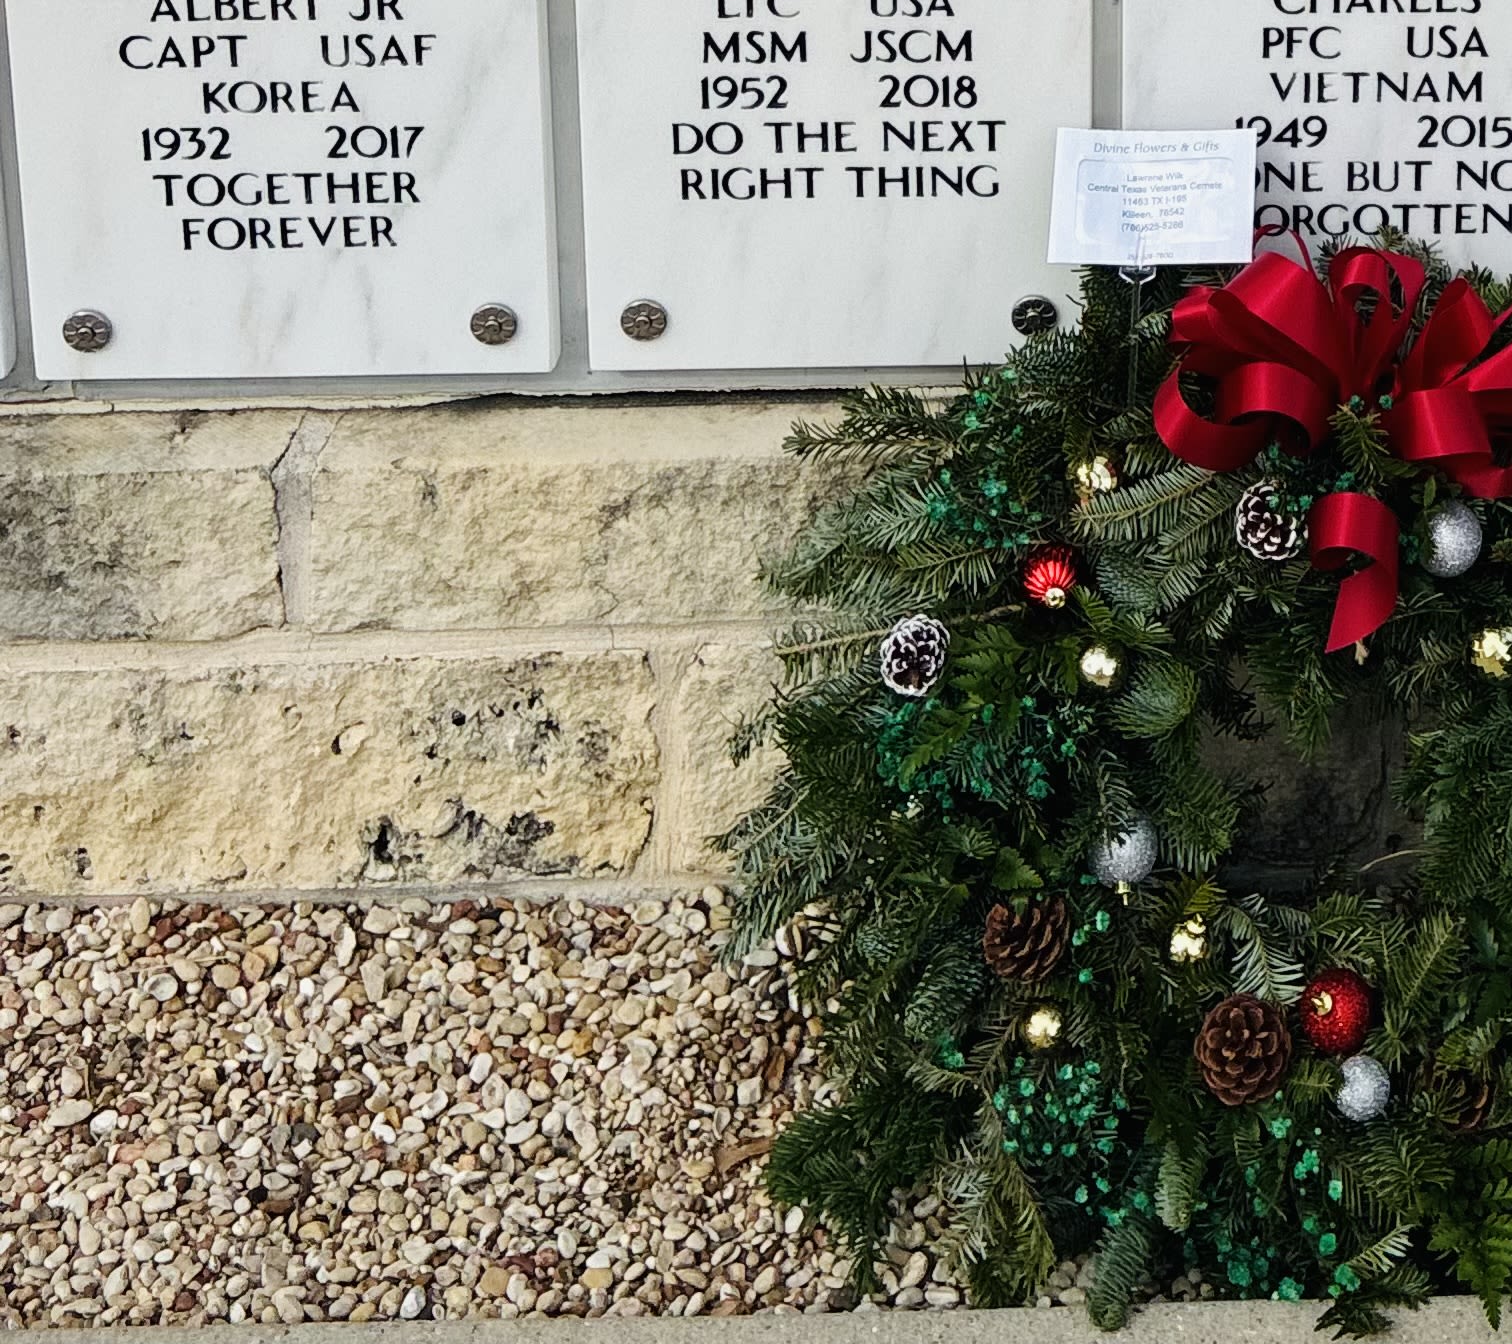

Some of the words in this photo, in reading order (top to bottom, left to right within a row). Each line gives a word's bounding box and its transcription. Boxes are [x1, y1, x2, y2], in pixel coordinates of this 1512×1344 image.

[117, 34, 249, 71] CAPT
[319, 32, 438, 69] USAF
[702, 29, 808, 65] MSM
[849, 28, 974, 64] JSCM
[1261, 25, 1342, 60] PFC
[1405, 24, 1490, 60] USA
[671, 120, 745, 156] DO
[762, 120, 858, 155] THE
[881, 119, 1007, 153] NEXT
[1093, 142, 1130, 153] Divine
[1134, 142, 1177, 153] Flowers
[1193, 140, 1220, 152] Gifts
[151, 170, 422, 208] TOGETHER
[1087, 183, 1119, 192] Central
[1121, 184, 1147, 193] Texas
